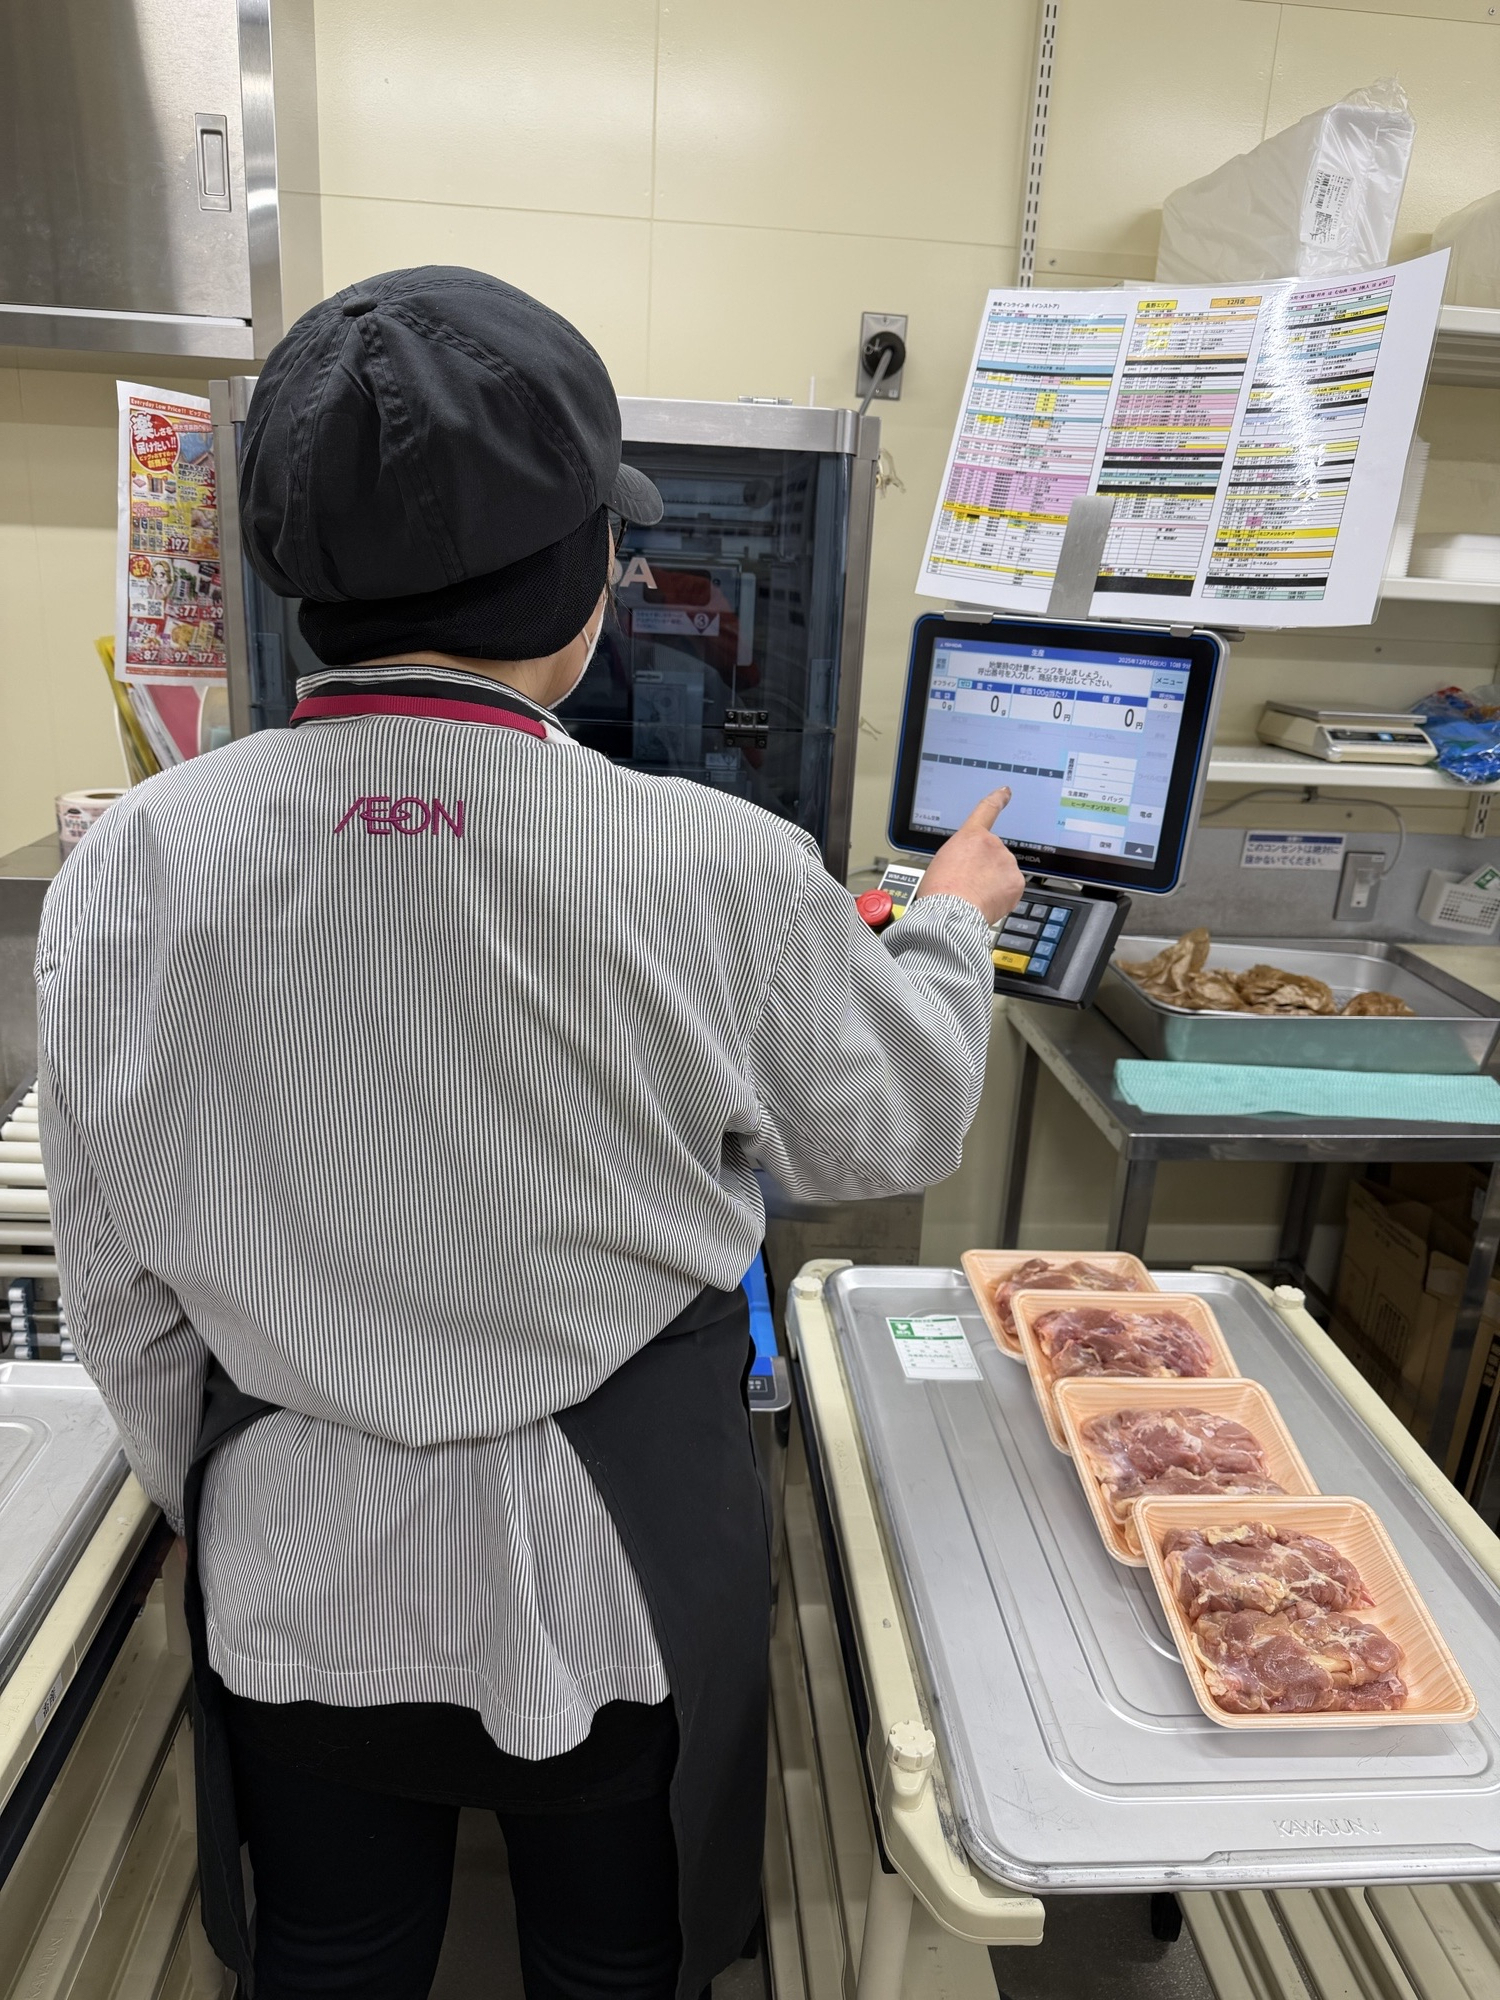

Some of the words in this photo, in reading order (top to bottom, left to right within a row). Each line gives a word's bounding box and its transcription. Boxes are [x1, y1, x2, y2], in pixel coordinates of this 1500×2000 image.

[130, 398, 155, 409] Everyday
[167, 406, 187, 414] Price!!
[131, 413, 174, 441] 楽しさを
[1031, 649, 1045, 658] 生産
[977, 667, 1113, 688] 呼出番号を入力し、商品を呼出して下さい。
[988, 661, 1103, 679] 始業時の計量チェックをしましょう。
[932, 680, 957, 688] オフライン
[1155, 677, 1183, 686] メニュー
[1020, 687, 1069, 699] 単価100g当たり
[990, 695, 1000, 713] 0
[1053, 701, 1063, 719] 0
[1124, 708, 1135, 727] 0
[1140, 811, 1153, 819] 電卓
[1246, 843, 1340, 855] このコンセントは絶対に
[1273, 1818, 1369, 1837] KAWAJUN
